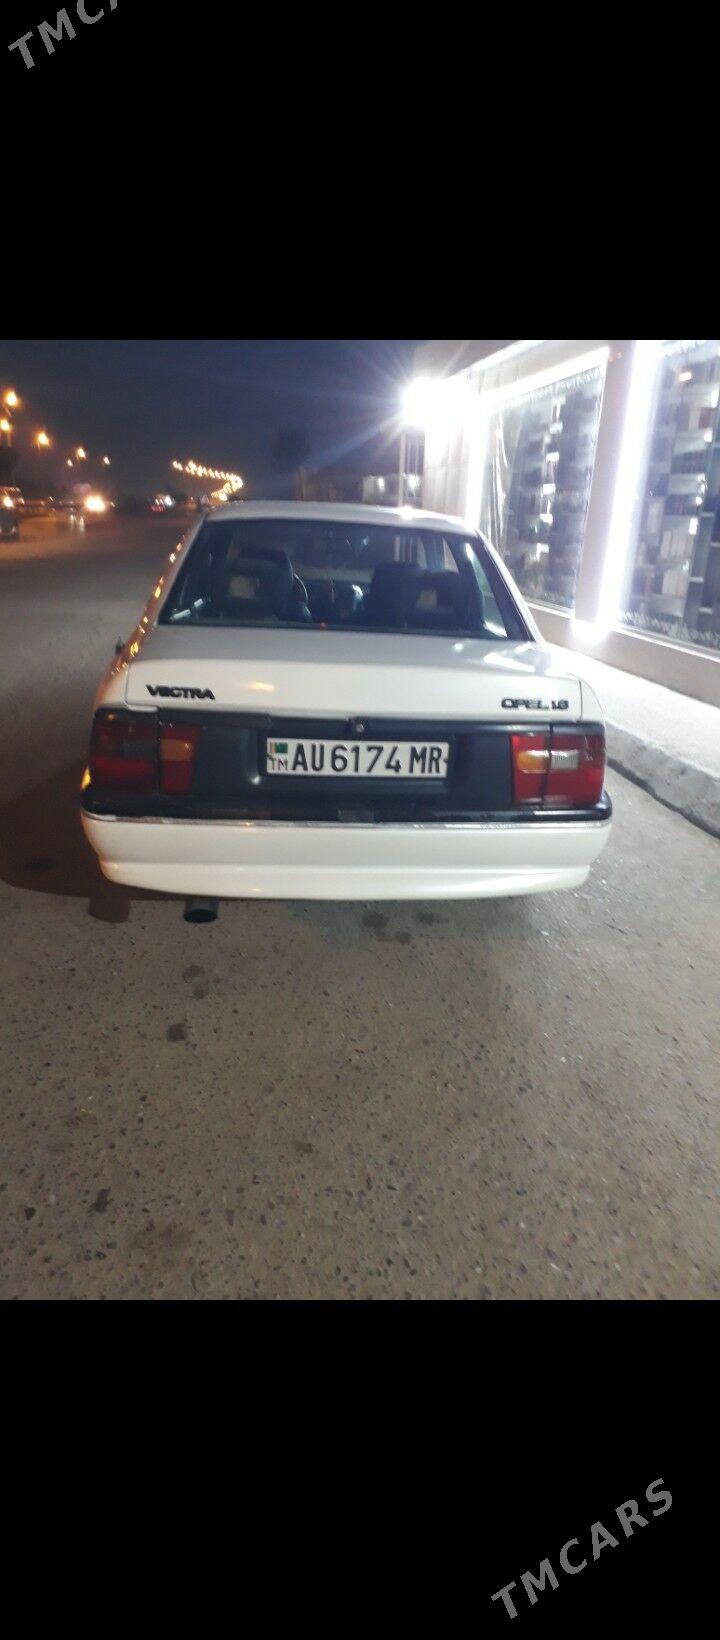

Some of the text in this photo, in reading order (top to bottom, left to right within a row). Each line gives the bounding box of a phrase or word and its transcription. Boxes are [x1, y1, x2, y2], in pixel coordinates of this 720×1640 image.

[145, 684, 216, 700] VECTRA
[269, 757, 288, 771] TM
[292, 743, 442, 774] AU 6174 MR
